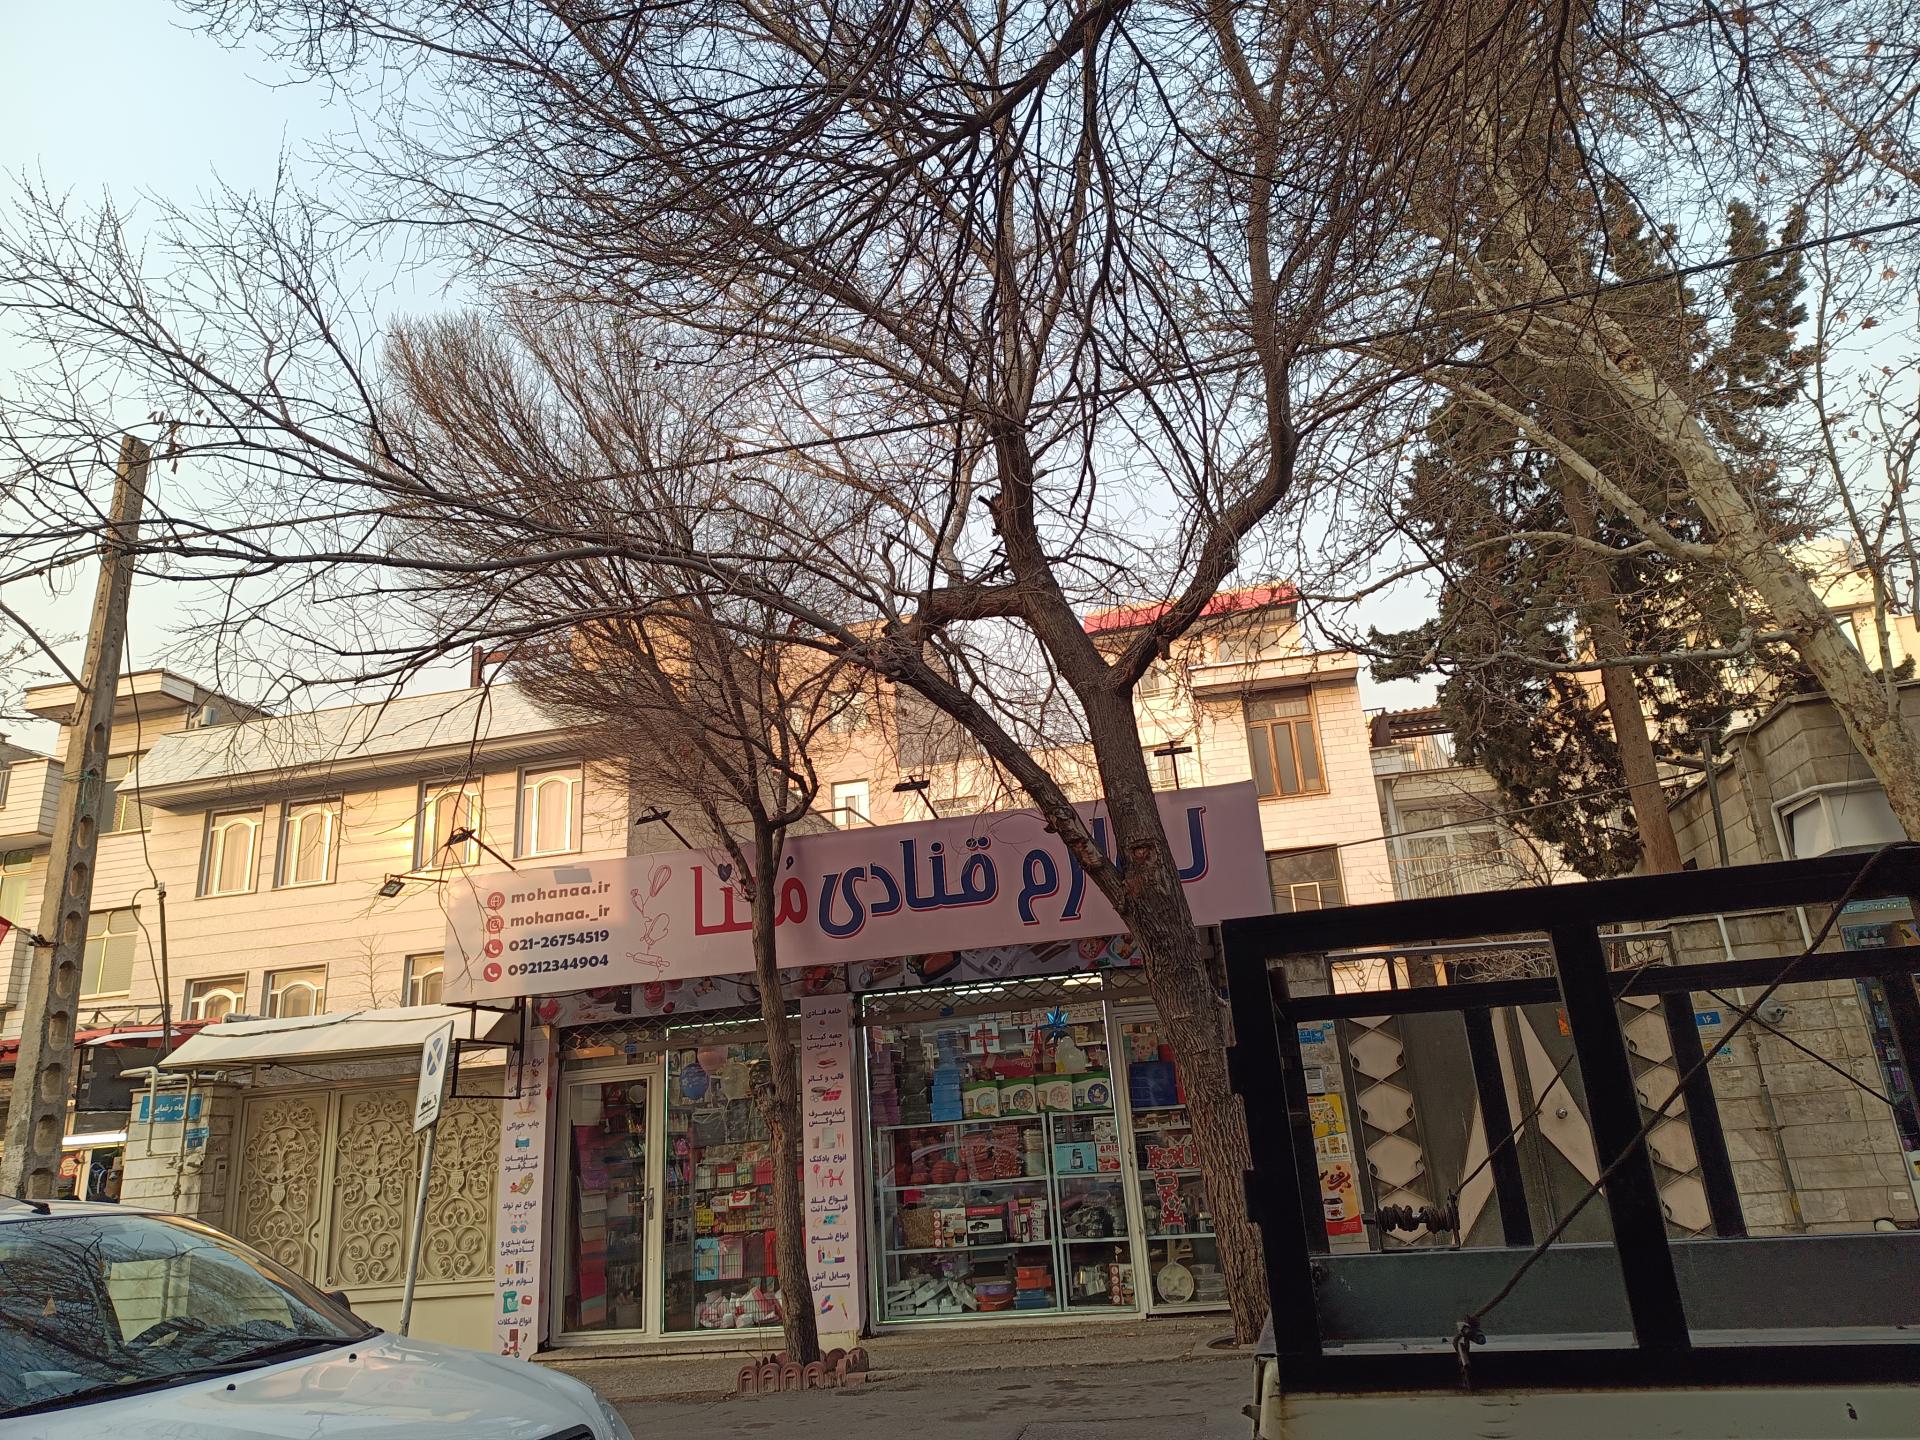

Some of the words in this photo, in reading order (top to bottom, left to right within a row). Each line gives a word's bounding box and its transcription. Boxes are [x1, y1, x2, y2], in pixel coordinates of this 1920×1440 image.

[511, 881, 611, 903] mohanaa.ir
[819, 837, 999, 938] قنادی
[510, 904, 610, 927] mohanaa._ir
[508, 929, 610, 951] 021-26754519
[507, 954, 609, 976] 09212344904
[806, 1008, 827, 1019] قنادی
[827, 1007, 842, 1015] خامه
[1703, 1015, 1712, 1023] ۱۶
[806, 1032, 827, 1041] کیک
[828, 1032, 842, 1040] جعبه
[808, 1115, 846, 1127] لوکس
[809, 1155, 830, 1163] بادکنک
[832, 1154, 847, 1164] انواع
[828, 1194, 848, 1205] انواع
[502, 1202, 514, 1212] تولد
[514, 1203, 522, 1211] تم
[523, 1201, 537, 1211] انواع
[811, 1233, 833, 1244] شمع
[834, 1231, 849, 1242] انواع
[505, 1239, 521, 1248] بندی
[515, 1276, 534, 1287] لوازم
[829, 1271, 851, 1282] وسایل
[499, 1277, 514, 1288] برقی
[812, 1282, 851, 1292] بازی
[497, 1317, 518, 1327] شکلات
[518, 1317, 532, 1328] انواع
